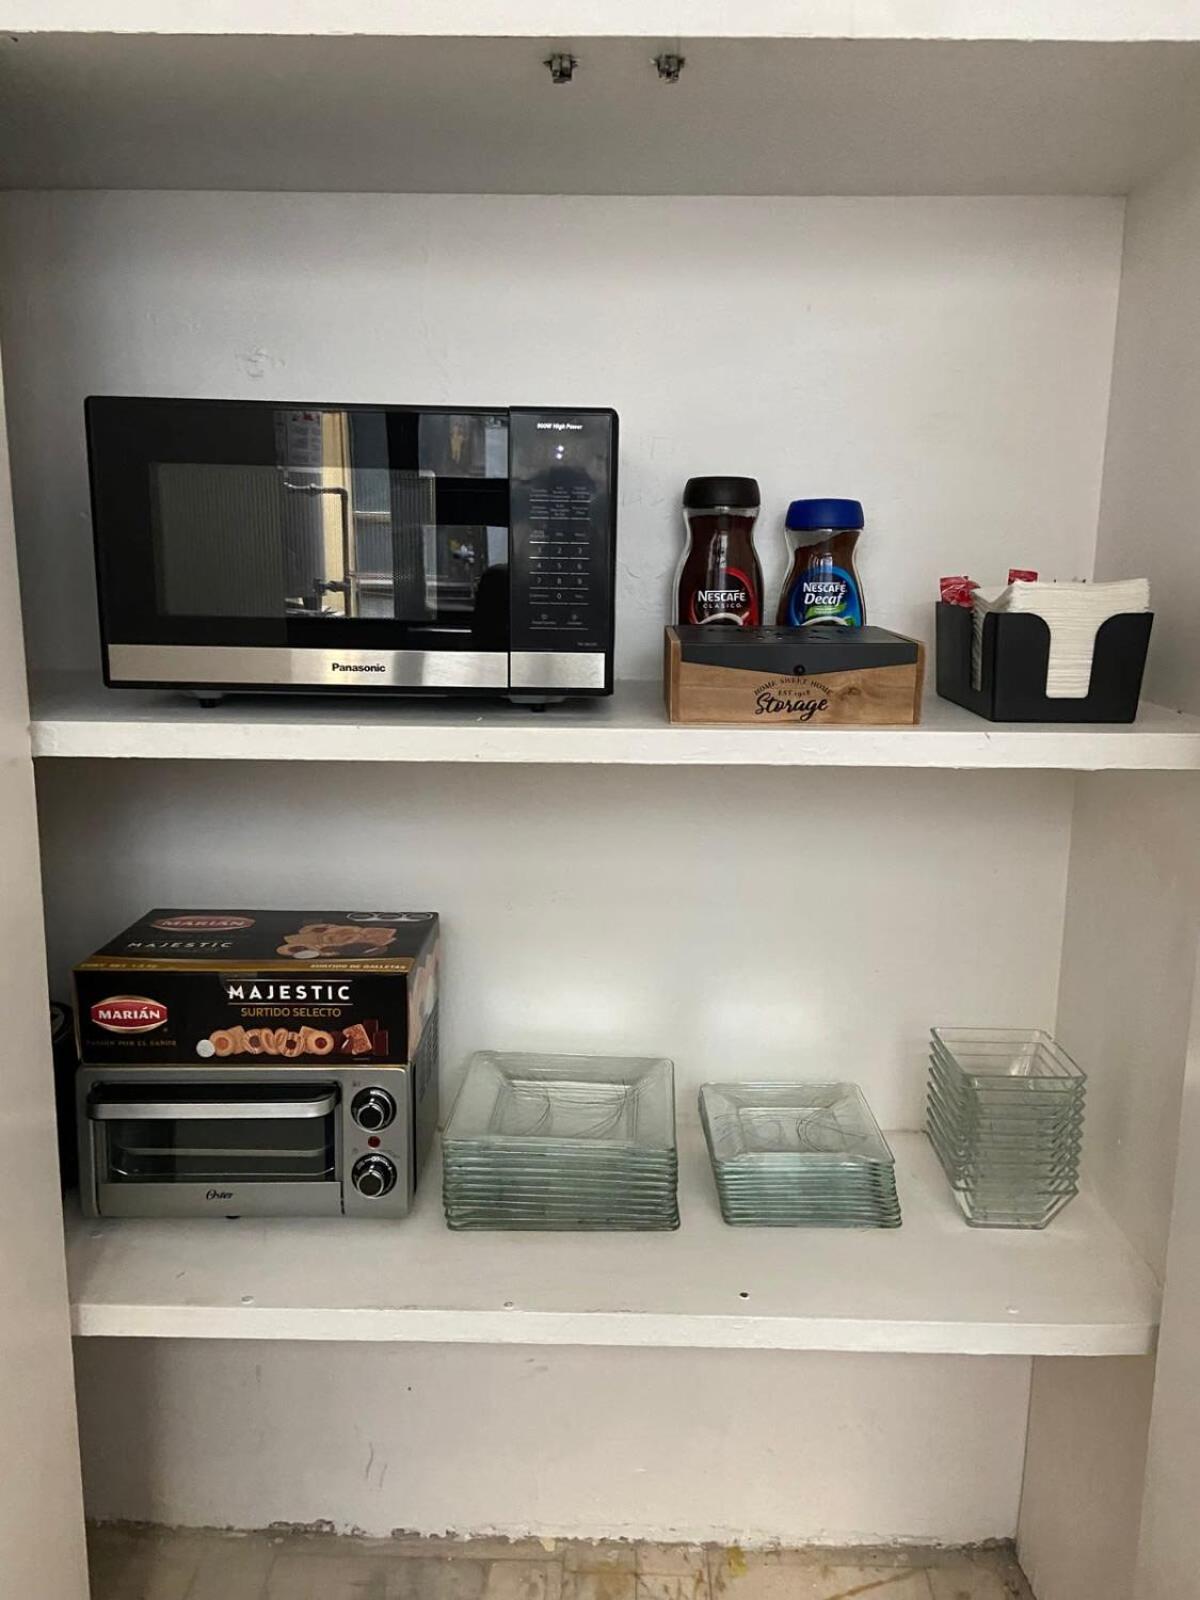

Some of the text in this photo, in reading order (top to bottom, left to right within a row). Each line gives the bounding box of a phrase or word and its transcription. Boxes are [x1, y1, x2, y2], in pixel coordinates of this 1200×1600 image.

[804, 592, 845, 607] Decaf
[332, 662, 386, 672] Panasonic
[755, 692, 829, 721] Storage
[228, 984, 350, 1000] MAJESTIC
[98, 1006, 161, 1019] MARIÁN
[240, 1007, 341, 1018] SURTIDO SELECTO
